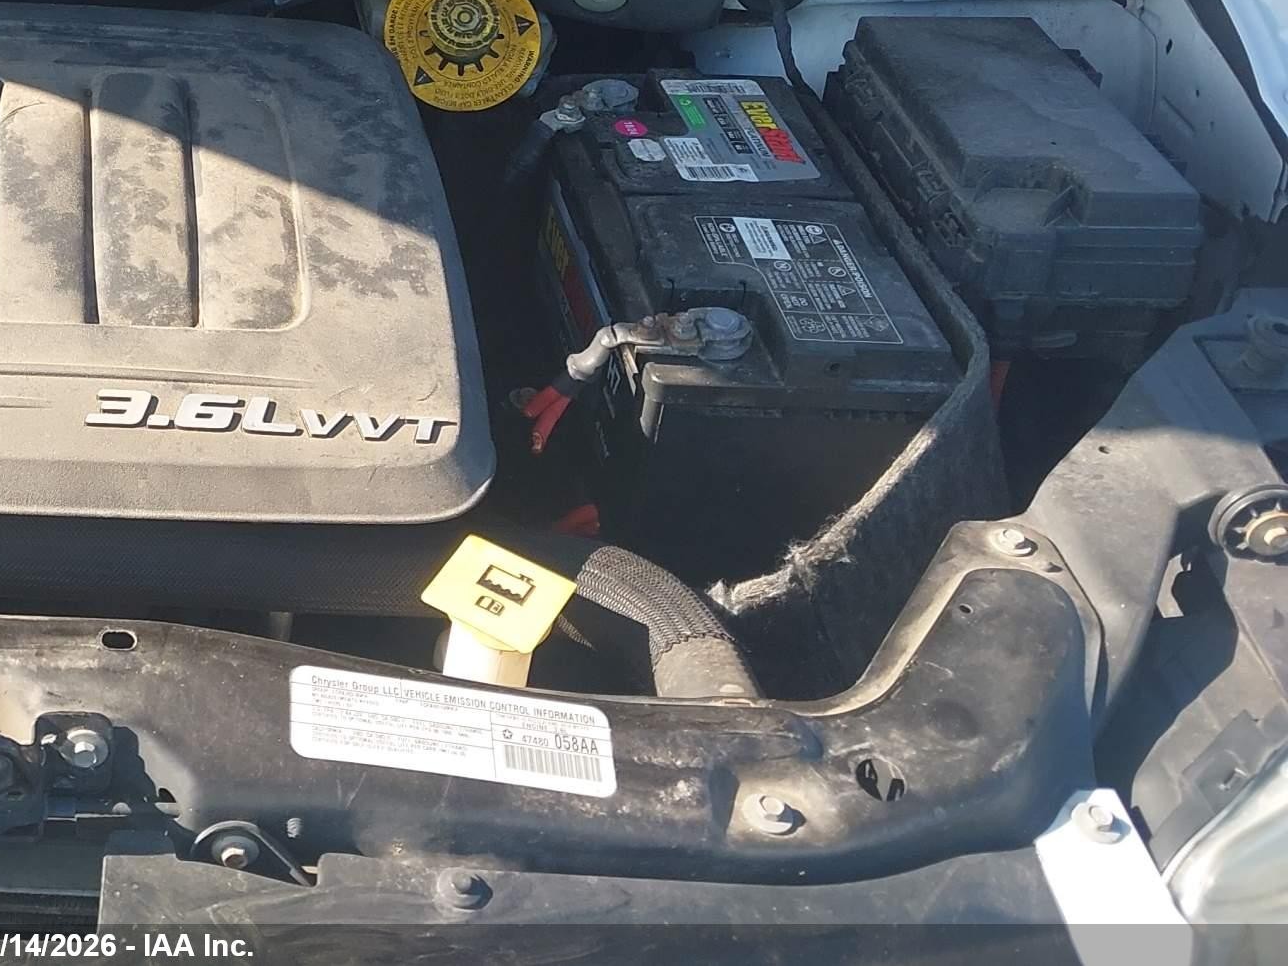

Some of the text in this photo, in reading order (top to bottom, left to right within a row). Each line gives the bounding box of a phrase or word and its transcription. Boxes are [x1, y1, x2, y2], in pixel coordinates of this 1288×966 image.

[312, 675, 400, 696] Chrysler Group LLC
[404, 689, 440, 702] VEHICLE
[444, 694, 486, 708] EMISSION
[490, 700, 530, 716] CONTROL
[534, 708, 595, 725] INFORMATION
[555, 734, 599, 754] 058AA
